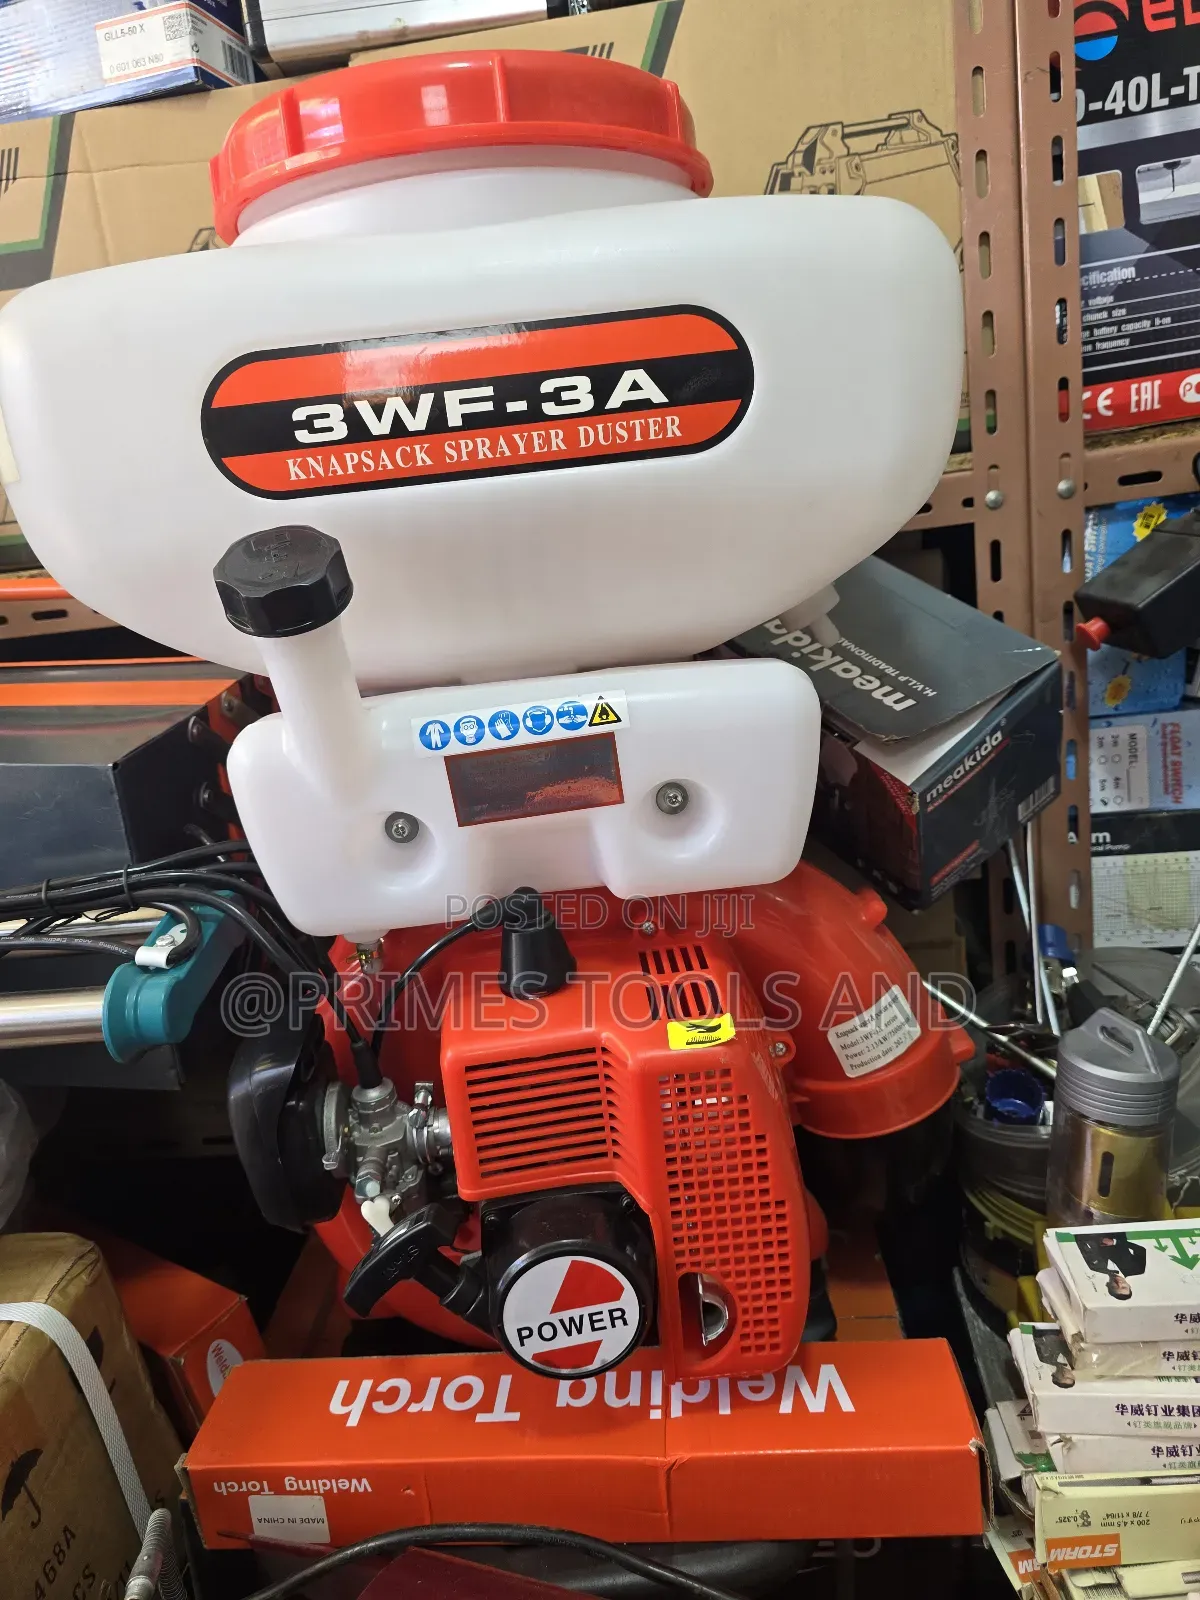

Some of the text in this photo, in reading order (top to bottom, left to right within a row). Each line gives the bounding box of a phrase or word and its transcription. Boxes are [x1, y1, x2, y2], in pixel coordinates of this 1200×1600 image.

[138, 23, 146, 34] X
[292, 369, 669, 443] 3WF-3A
[286, 415, 682, 481] KNAPSACK SPRAYER DUSTER
[926, 730, 1003, 802] meakida
[516, 1307, 629, 1348] POWER
[328, 1374, 521, 1427] Torch
[213, 1476, 373, 1496] Welding Torch
[256, 1517, 325, 1525] MADE IN CHINA
[1137, 1518, 1151, 1527] 200
[1049, 1543, 1119, 1562] STORM
